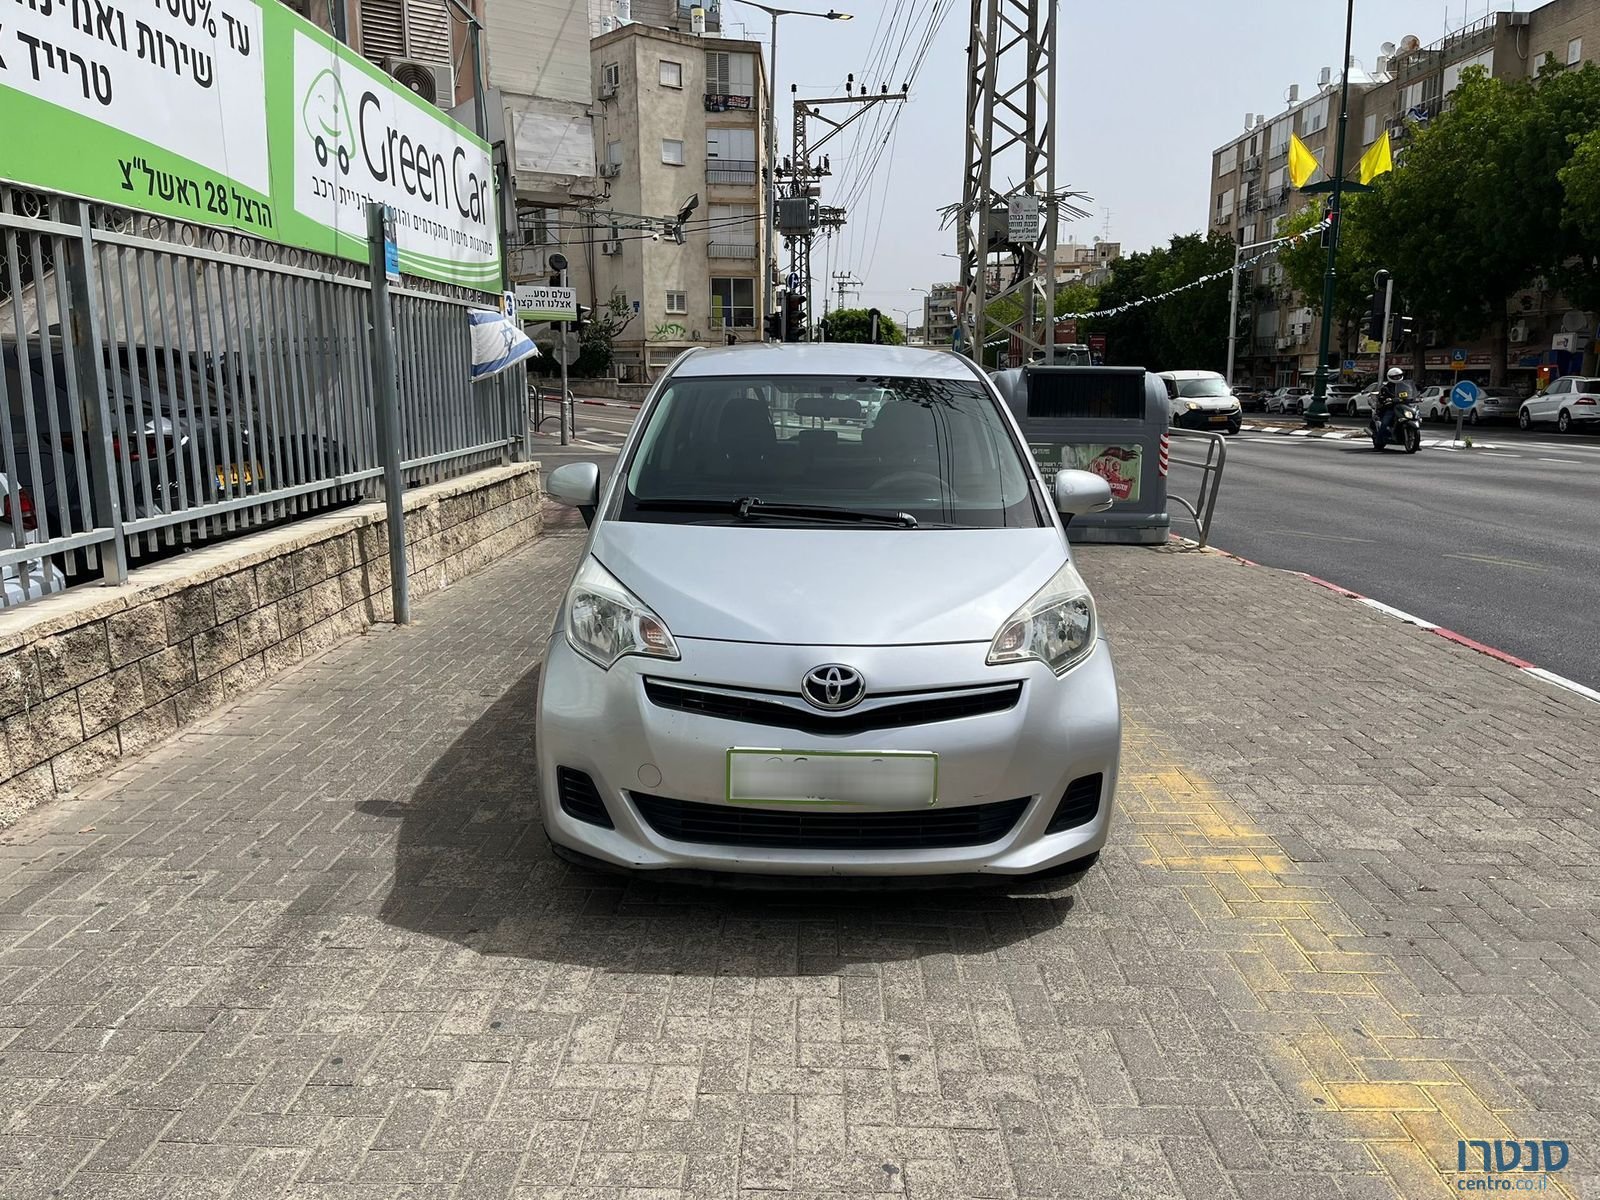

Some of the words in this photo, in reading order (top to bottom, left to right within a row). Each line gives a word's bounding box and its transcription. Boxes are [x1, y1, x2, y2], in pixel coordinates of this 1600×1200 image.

[155, 0, 217, 38] 0%
[222, 11, 250, 56] עד
[17, 30, 112, 106] טרייד
[135, 19, 213, 88] שירות
[359, 91, 448, 209] Green
[453, 146, 487, 225] Car
[205, 180, 229, 216] 28
[312, 176, 335, 201] רכב
[231, 187, 273, 228] הרצל
[413, 214, 448, 240] מתקדמים
[450, 228, 468, 247] מימון
[536, 299, 545, 307] זה
[548, 299, 571, 308] אצלנו
[552, 290, 571, 298] שלם
